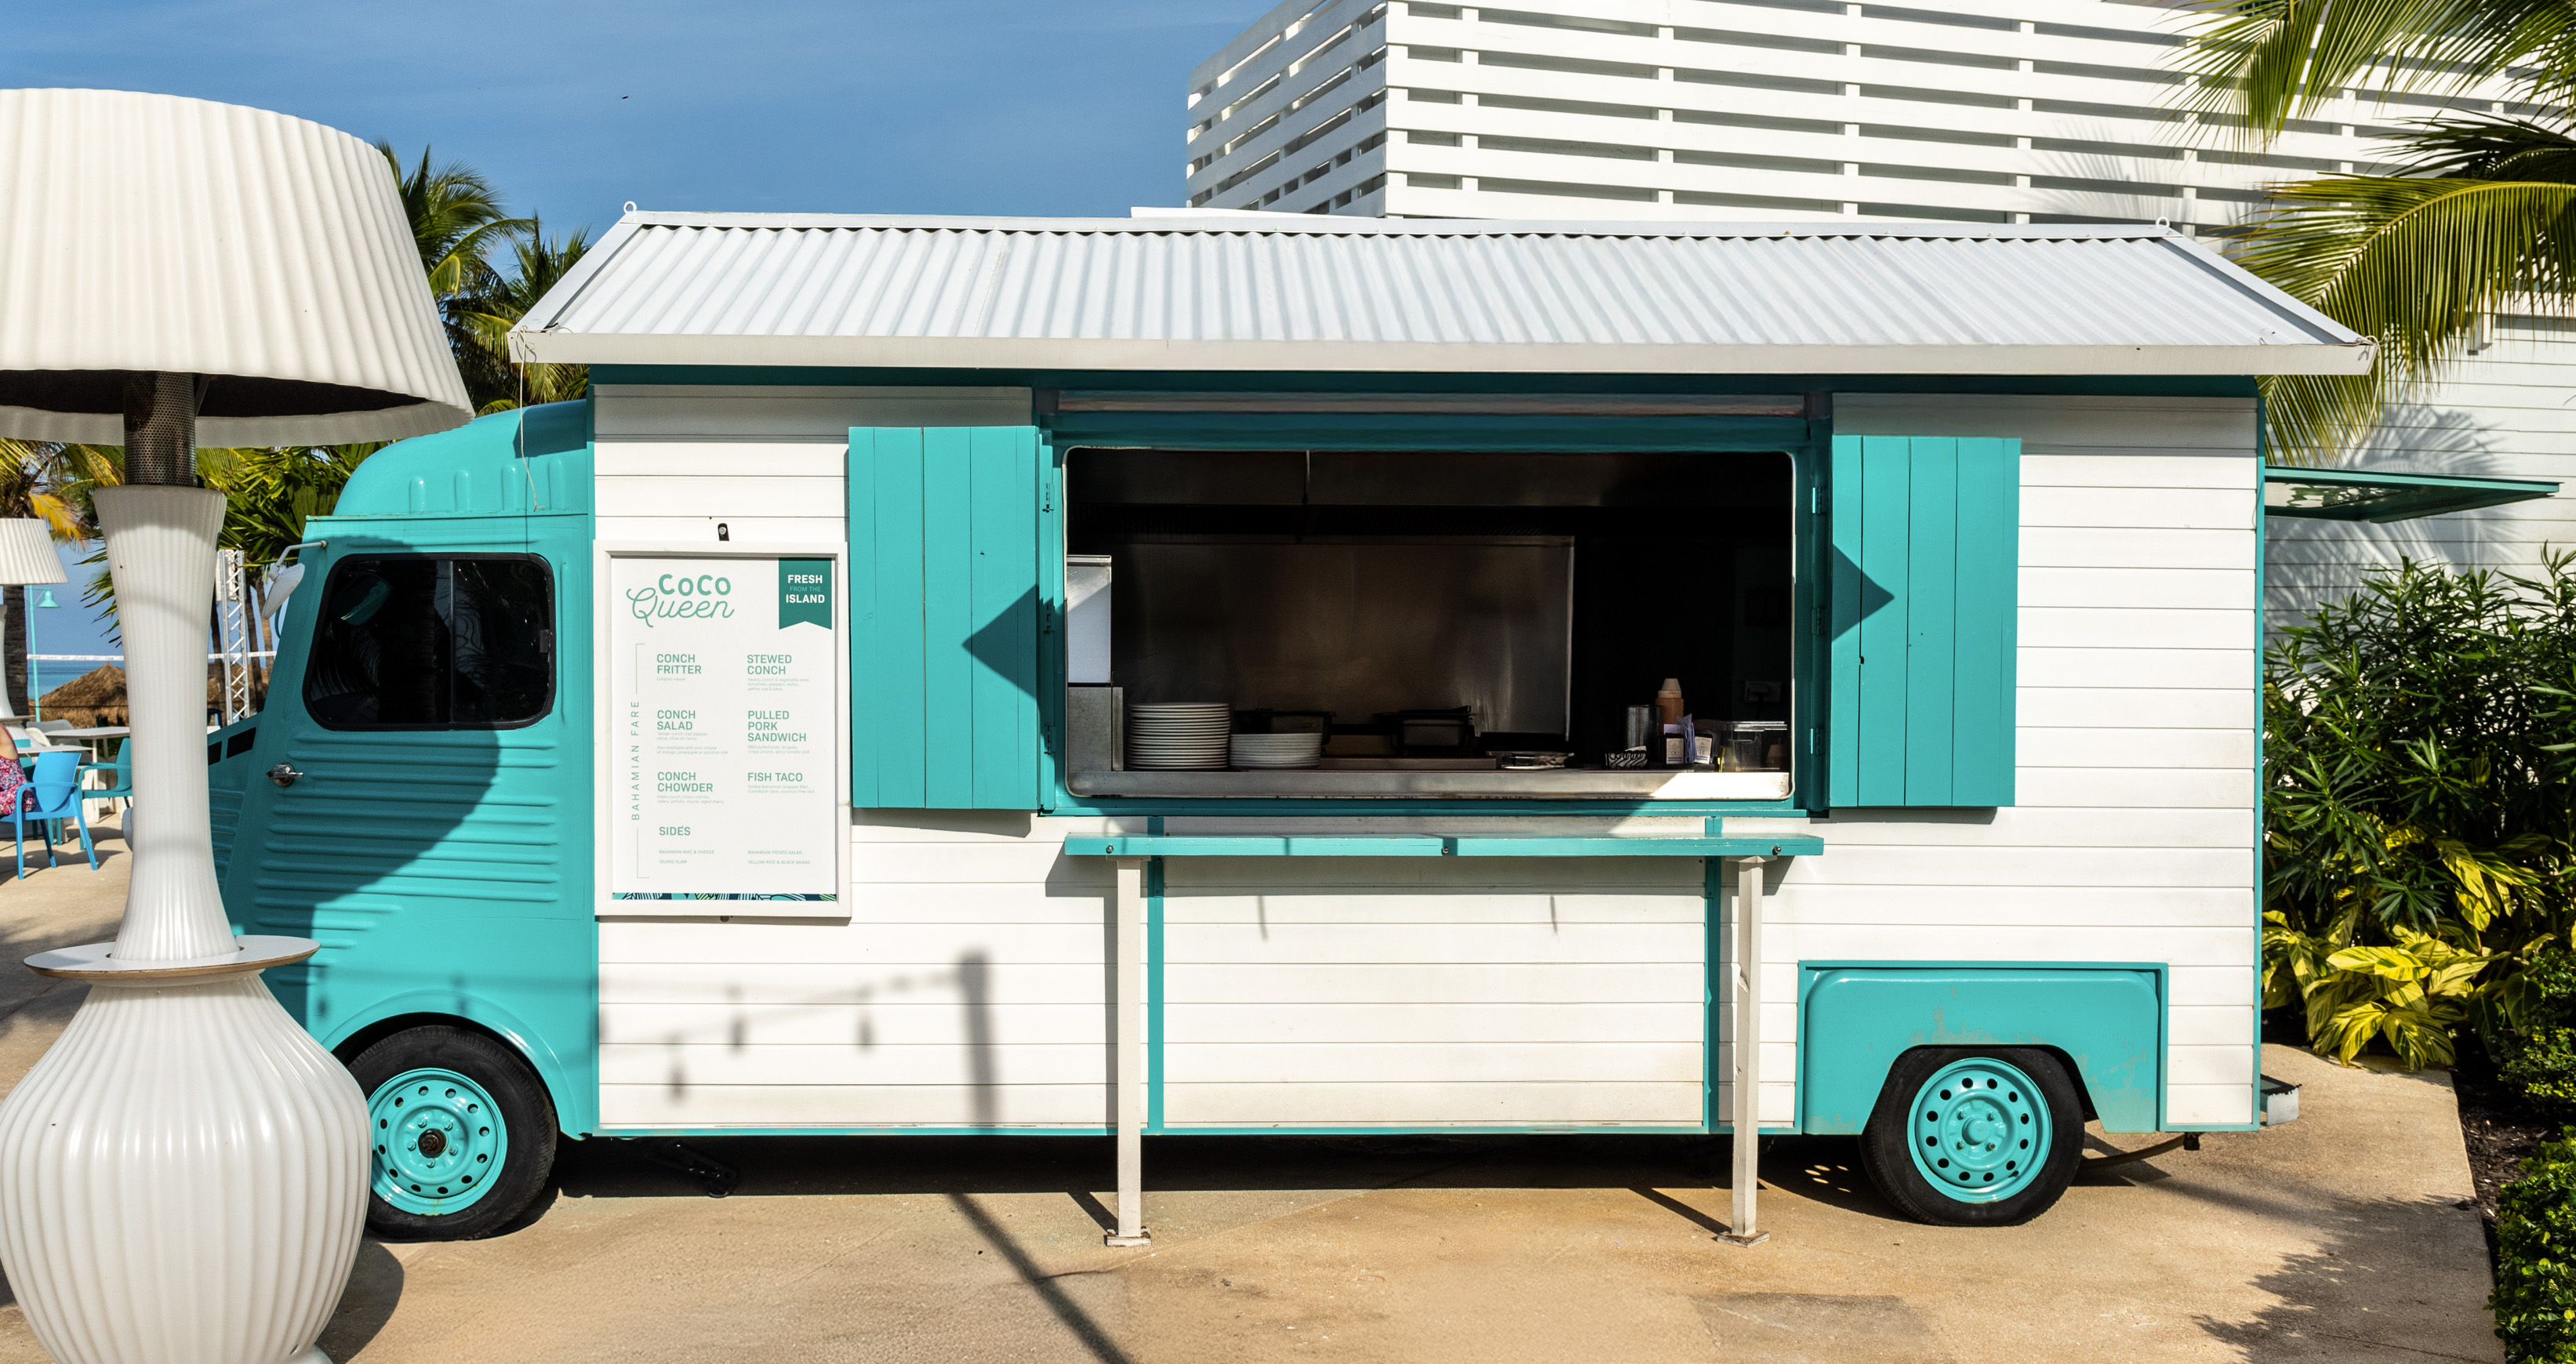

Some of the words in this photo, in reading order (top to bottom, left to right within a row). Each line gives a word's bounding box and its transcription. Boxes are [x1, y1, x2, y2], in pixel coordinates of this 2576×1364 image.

[787, 575, 823, 584] FRESH
[786, 594, 825, 604] ISLAND
[627, 588, 734, 627] Queen
[656, 653, 696, 663] CONCH
[747, 654, 792, 664] STEWED
[656, 665, 702, 674] FRITTER
[747, 665, 786, 675] CONCH
[630, 702, 639, 735] FARE
[656, 709, 696, 720] CONCH
[747, 710, 790, 720] PULLED
[656, 720, 693, 731] SALAD
[747, 721, 778, 731] PORK
[747, 732, 807, 742] SANDWICH
[657, 771, 696, 782] CONCH
[747, 772, 772, 782] FISH
[775, 772, 803, 782] TACO
[631, 745, 640, 820] BAHAMIAN
[657, 782, 714, 793] CHOWDER
[659, 826, 691, 836] SIDES
